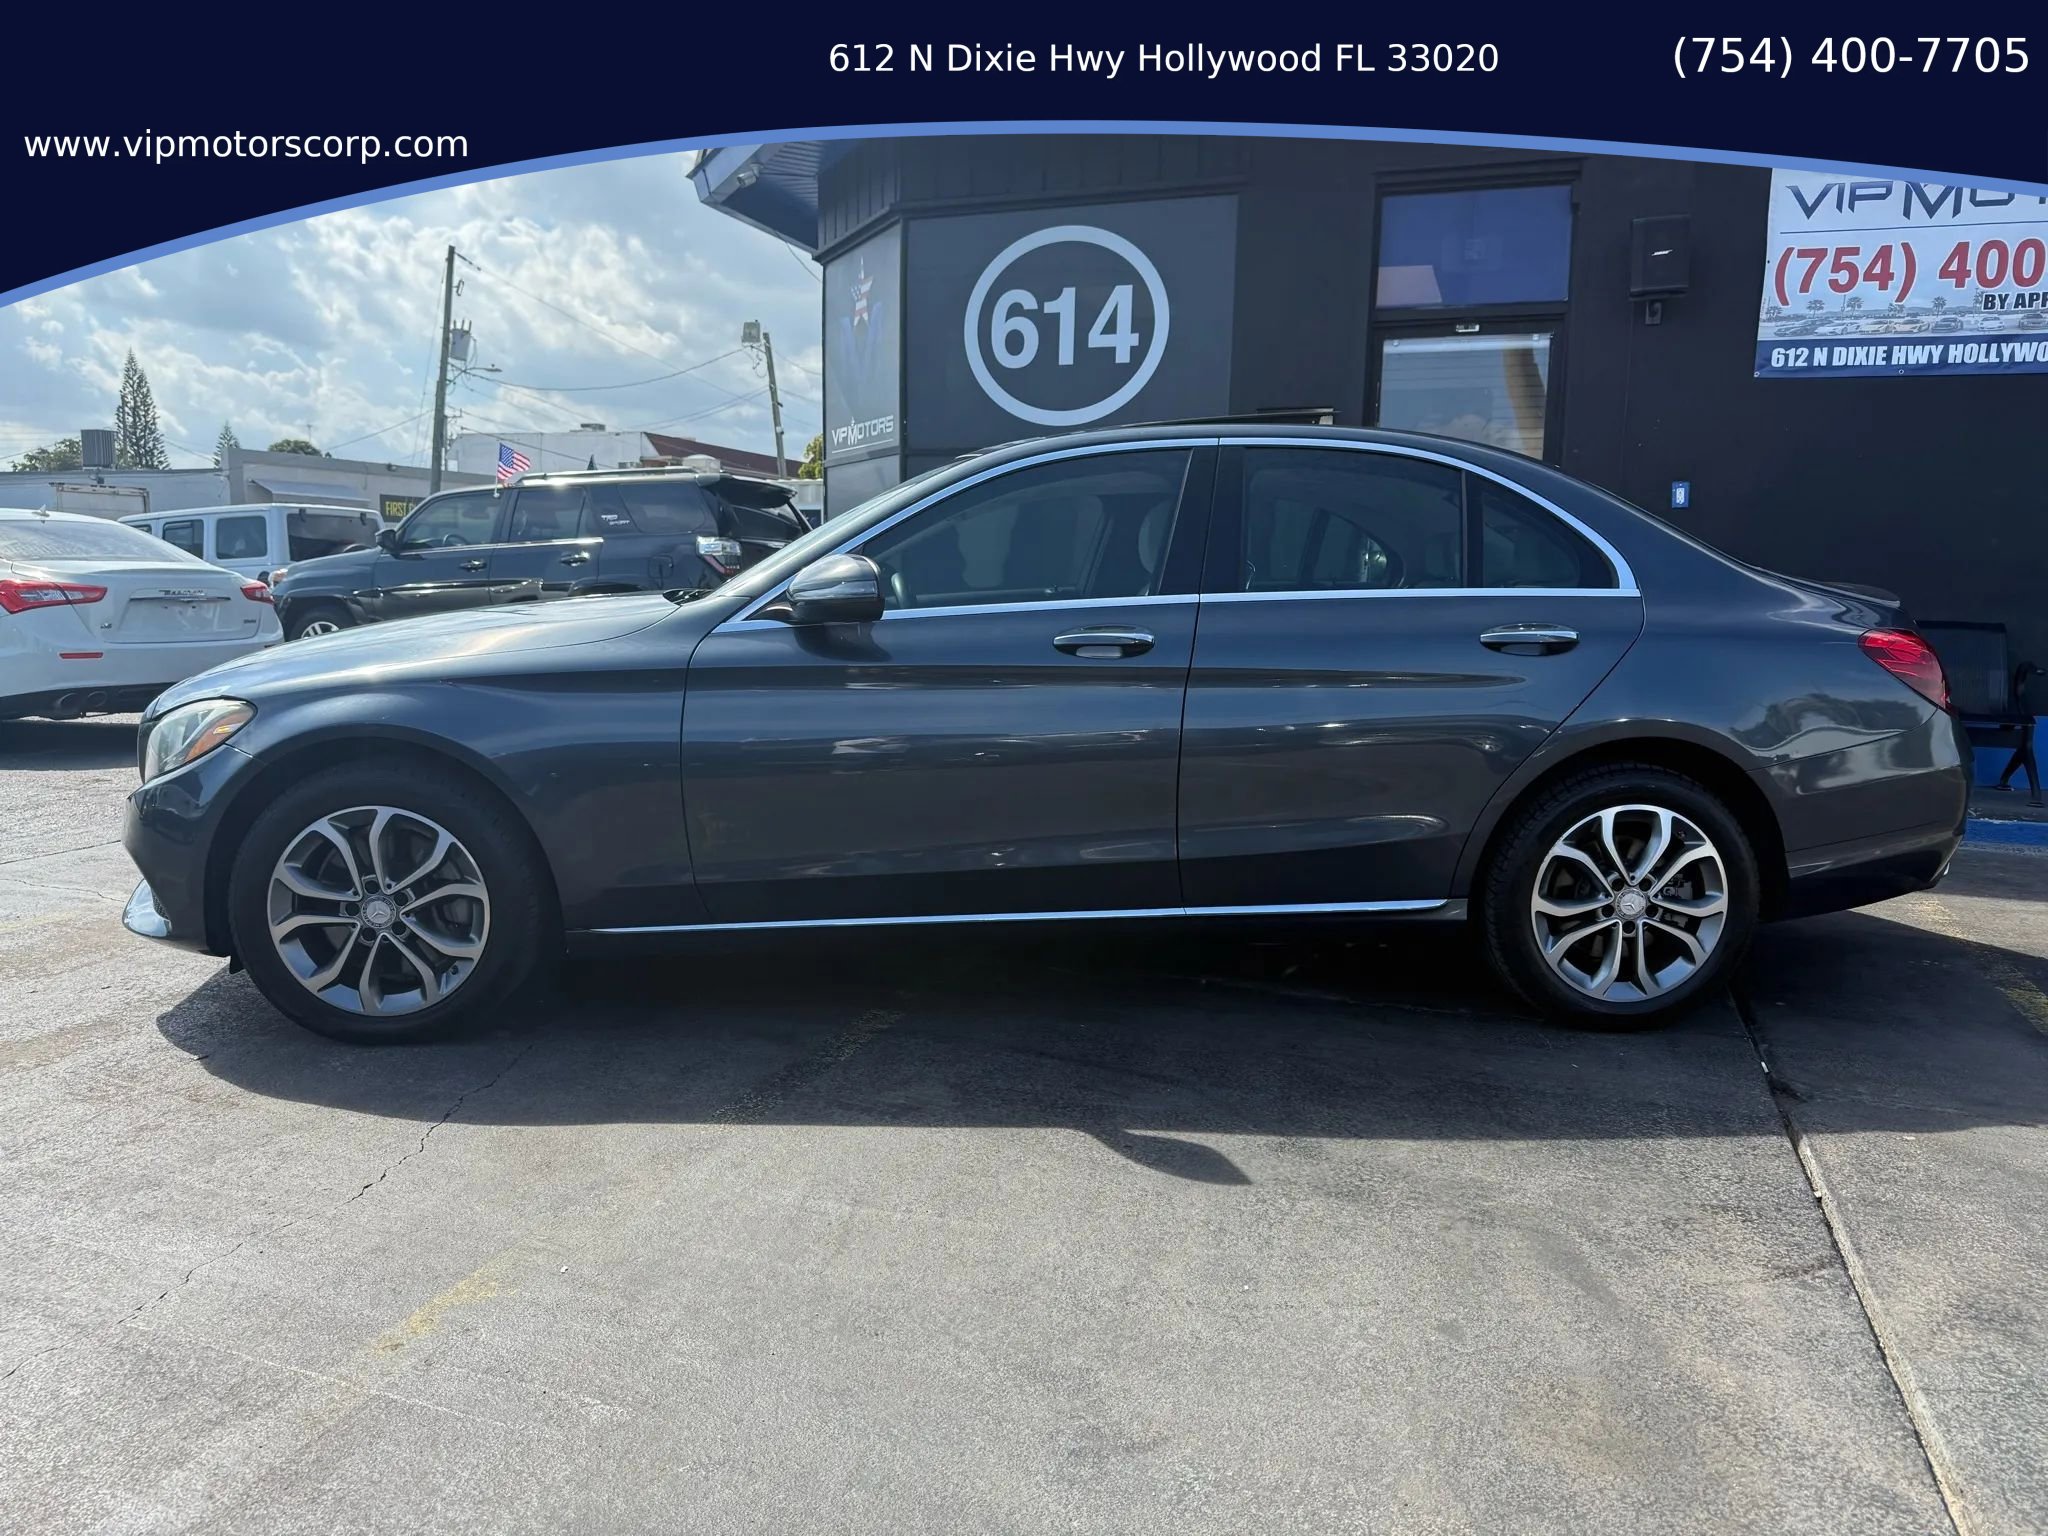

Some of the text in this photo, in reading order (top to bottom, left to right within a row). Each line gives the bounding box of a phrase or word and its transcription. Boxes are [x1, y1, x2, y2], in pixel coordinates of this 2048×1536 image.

[1774, 237, 2047, 306] (754) 400
[1983, 293, 2010, 310] BY
[990, 284, 1139, 369] 614
[1771, 341, 2048, 367] 612 N DIXIE HWY HOLLYWO
[385, 501, 407, 516] FIRST
